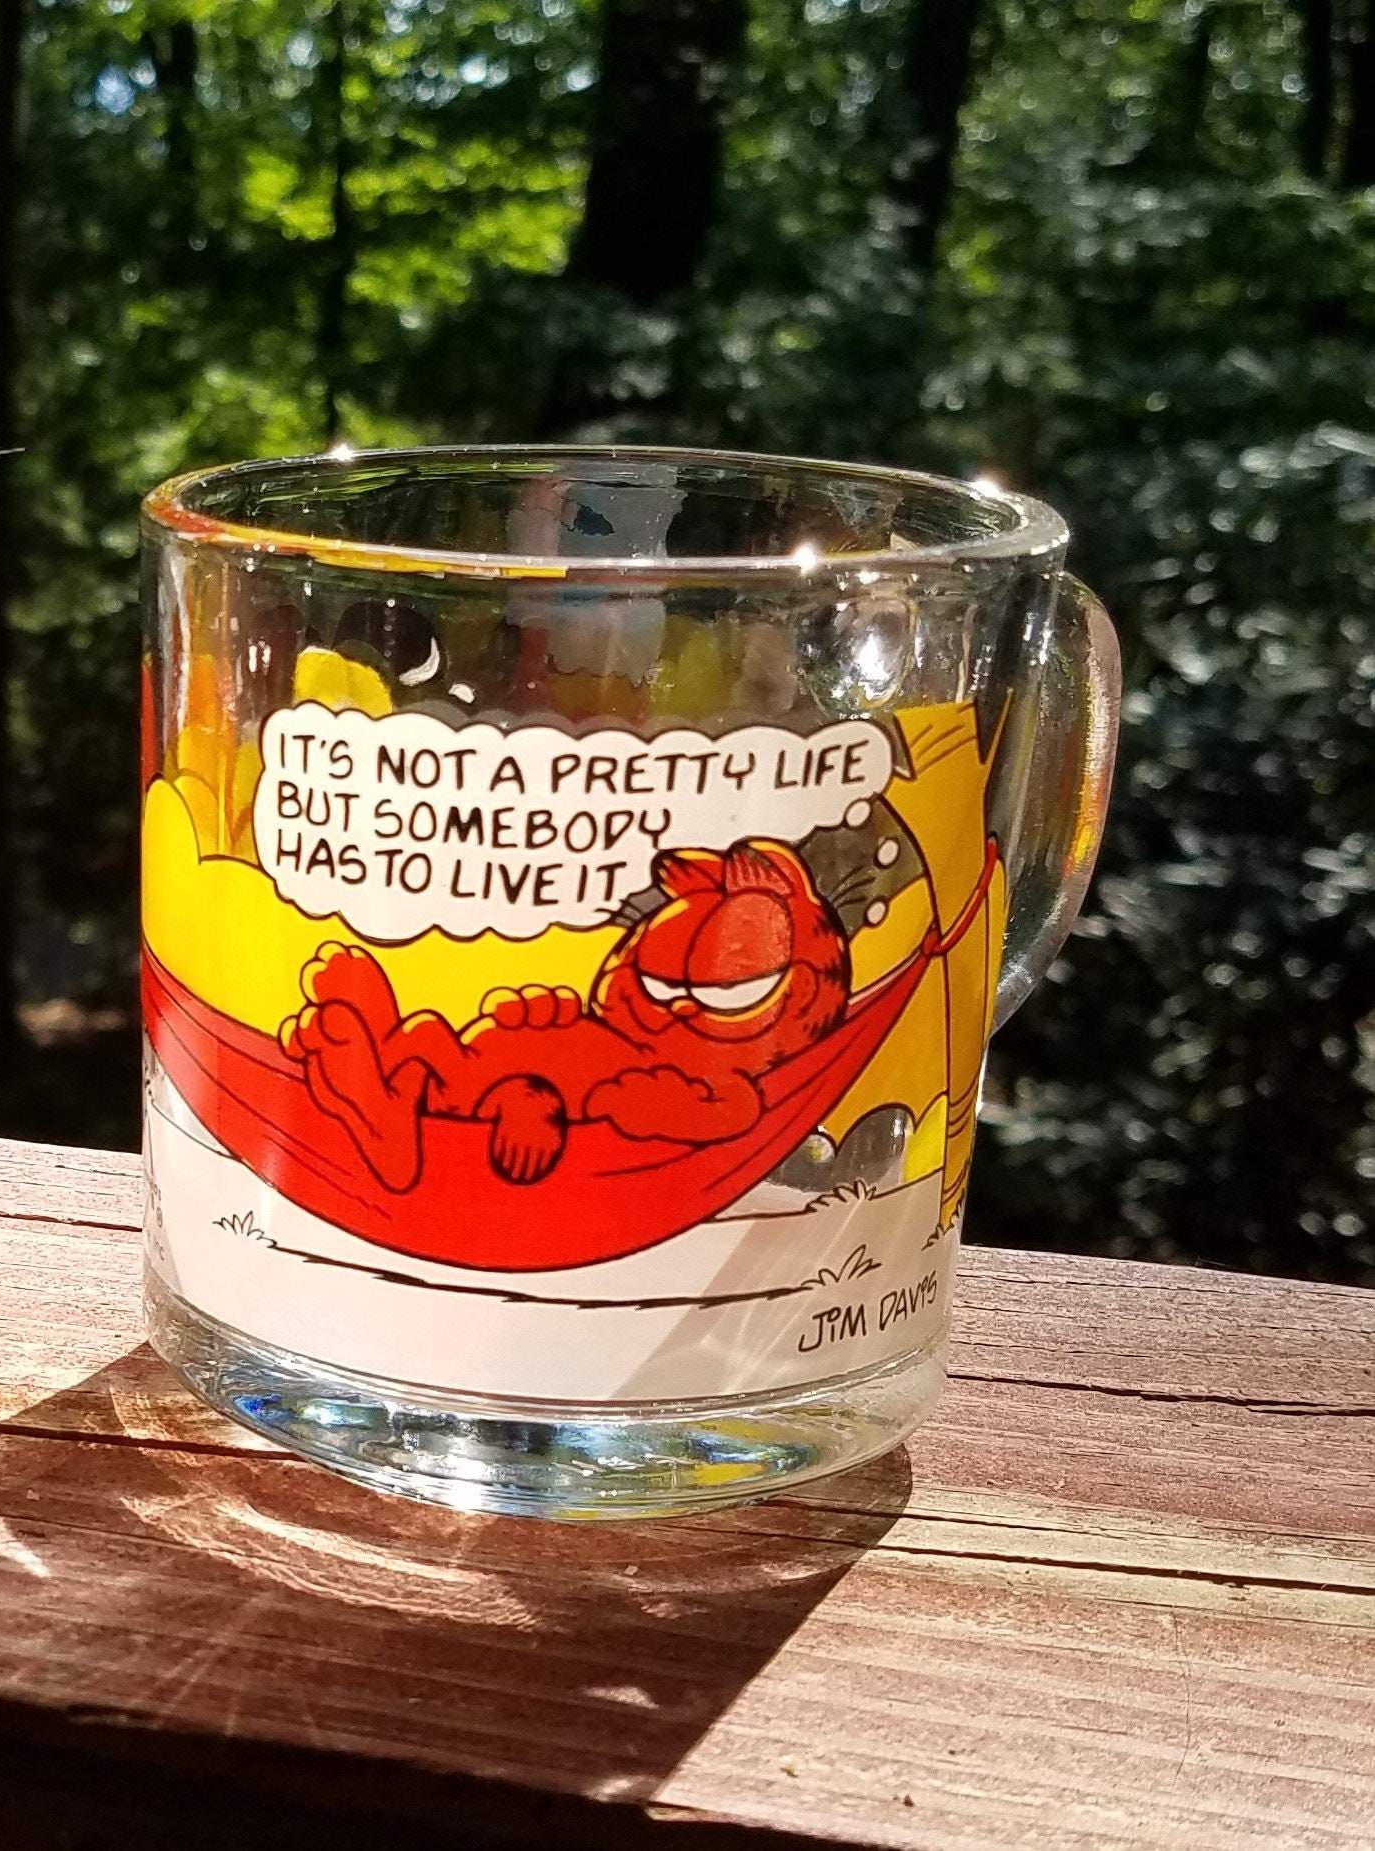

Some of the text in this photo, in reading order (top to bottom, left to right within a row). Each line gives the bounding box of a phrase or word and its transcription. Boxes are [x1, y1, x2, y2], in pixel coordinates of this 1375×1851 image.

[279, 733, 870, 795] IT'S NOT A PRETTY LIFE
[277, 780, 671, 853] BUT SOMEBODY
[276, 828, 626, 906] HAS TO LIVE IT
